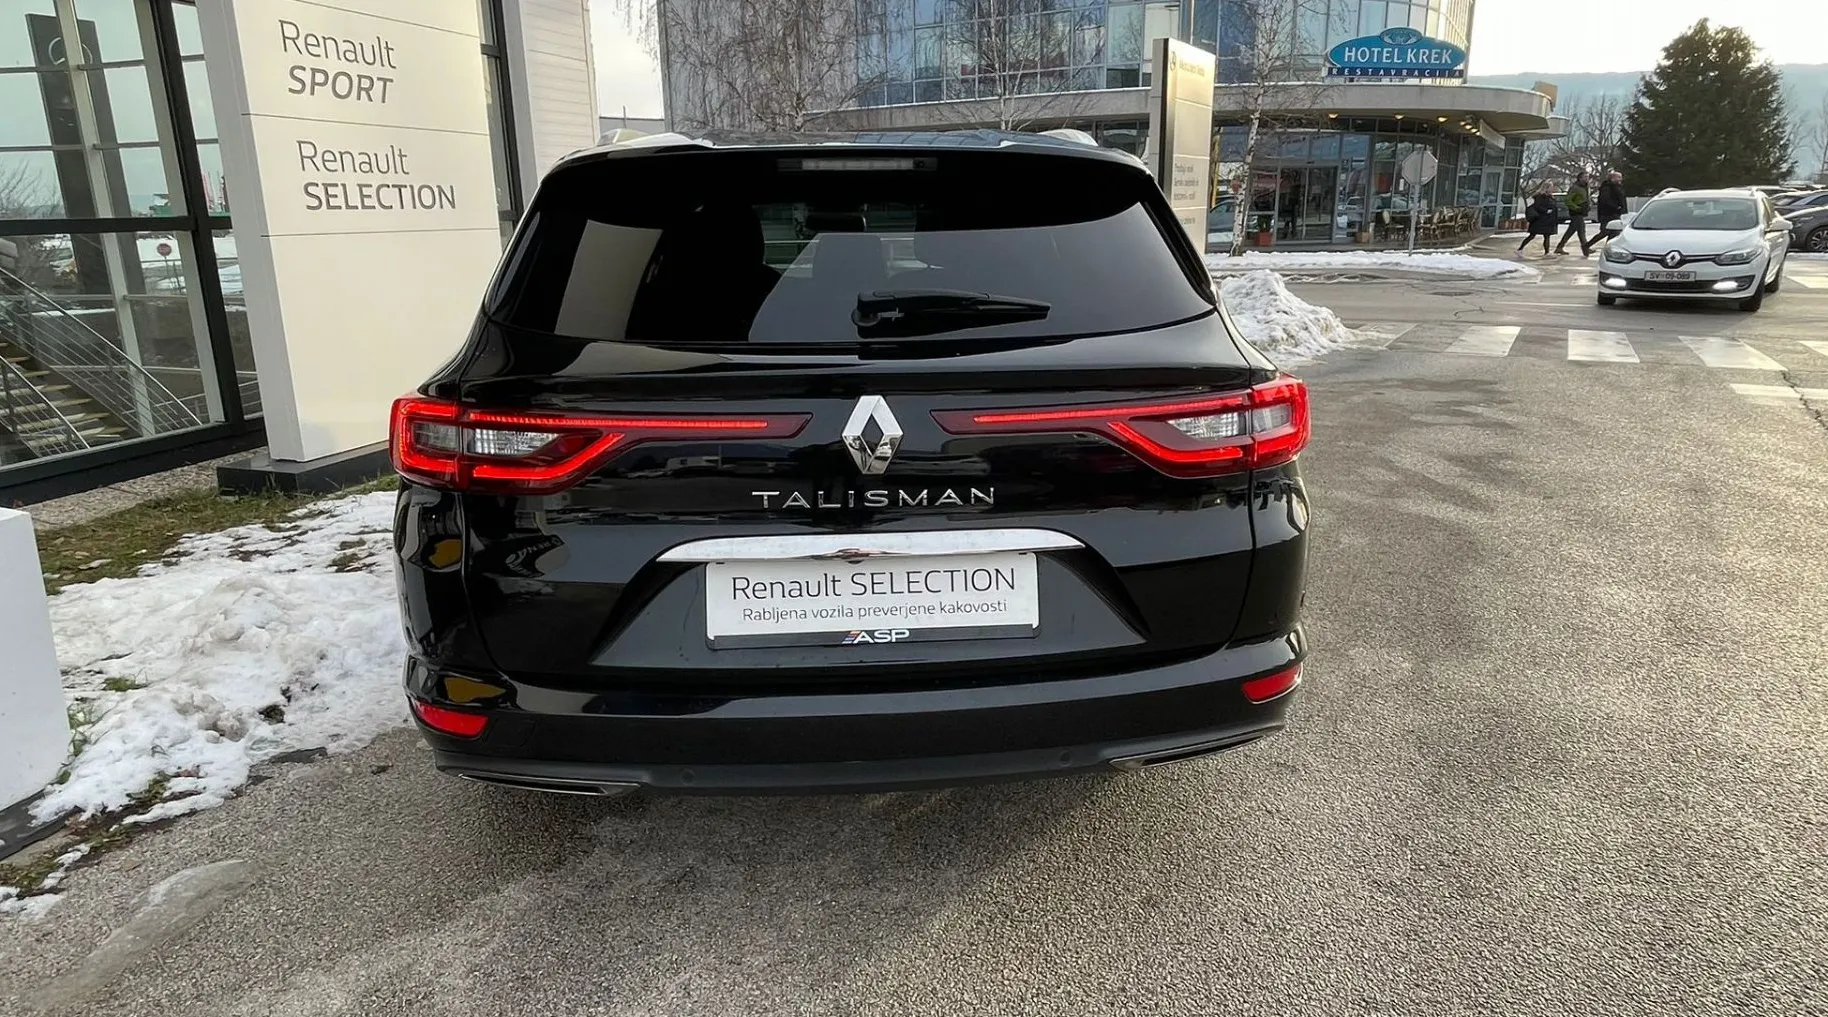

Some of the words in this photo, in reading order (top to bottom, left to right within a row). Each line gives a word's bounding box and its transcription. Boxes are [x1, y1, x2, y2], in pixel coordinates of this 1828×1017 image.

[278, 19, 397, 69] Renault
[1344, 47, 1402, 63] HOTEL
[1407, 49, 1452, 63] KREK
[288, 65, 394, 104] SPORT
[1332, 67, 1460, 77] RESTAVRACIJA
[296, 140, 410, 175] Renault
[303, 182, 456, 210] SELECTION
[751, 487, 995, 509] TALISMAN
[732, 574, 842, 600] Renault
[851, 567, 1016, 596] SELECTION
[743, 606, 808, 622] Rabljena
[811, 604, 854, 619] vozila
[858, 602, 936, 619] preverjene
[939, 599, 1008, 614] kakovosti
[851, 629, 910, 644] ASP
